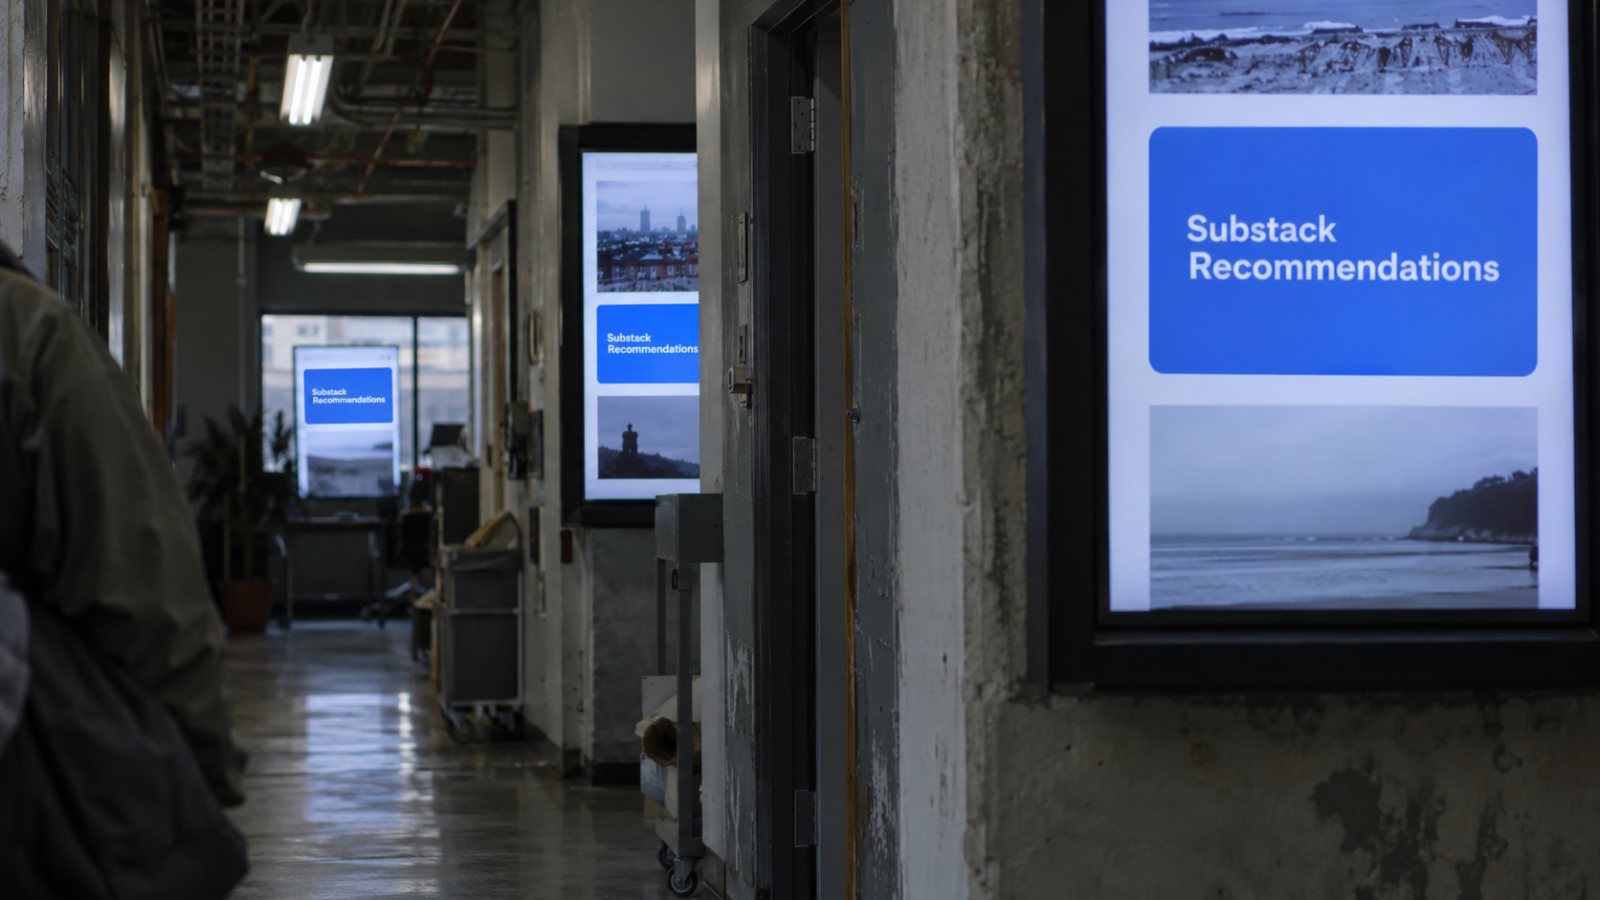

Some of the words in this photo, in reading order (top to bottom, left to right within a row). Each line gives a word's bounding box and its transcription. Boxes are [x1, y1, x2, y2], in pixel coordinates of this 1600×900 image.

[1187, 214, 1337, 242] Substack
[1189, 251, 1500, 282] Recommendations
[607, 333, 651, 342] Substack
[608, 344, 699, 354] Recommendations
[312, 396, 386, 404] Recommendations
